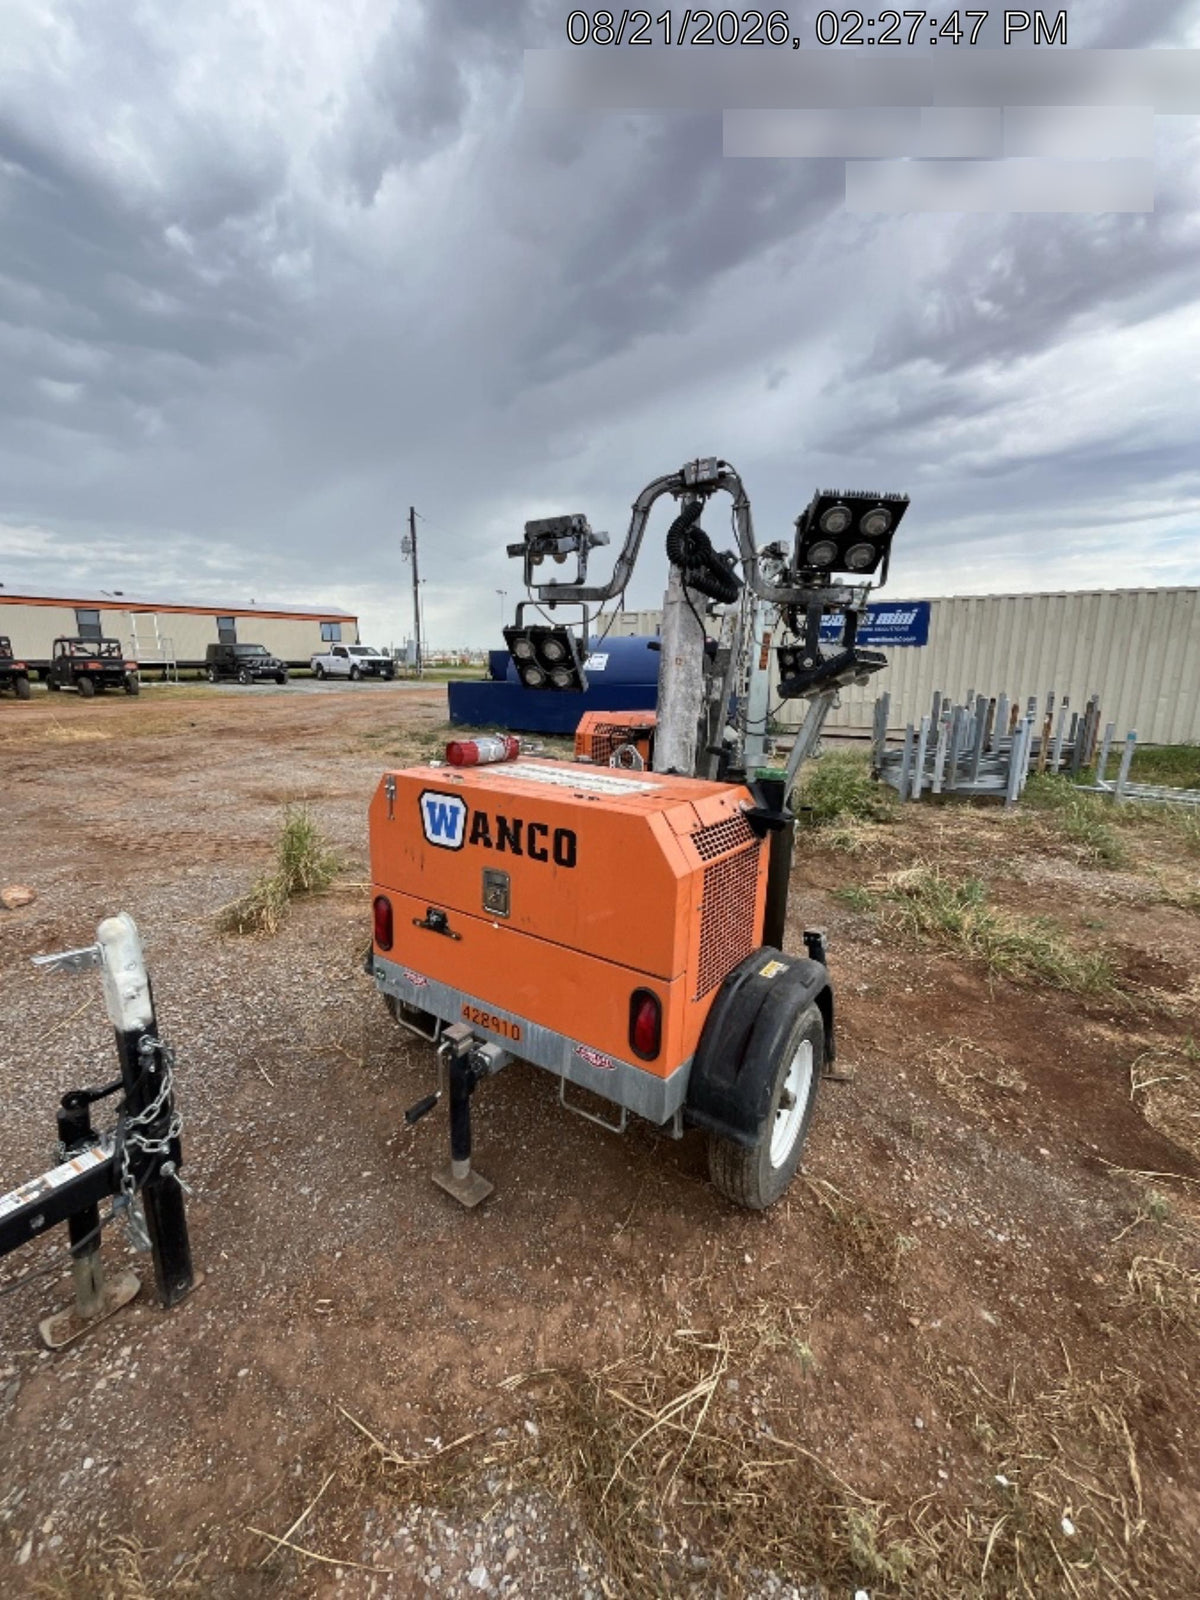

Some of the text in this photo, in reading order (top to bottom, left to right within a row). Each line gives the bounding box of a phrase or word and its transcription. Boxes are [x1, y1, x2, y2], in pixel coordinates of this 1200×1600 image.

[875, 608, 919, 625] mini
[424, 798, 577, 868] WANCO
[461, 1004, 521, 1042] 428910
